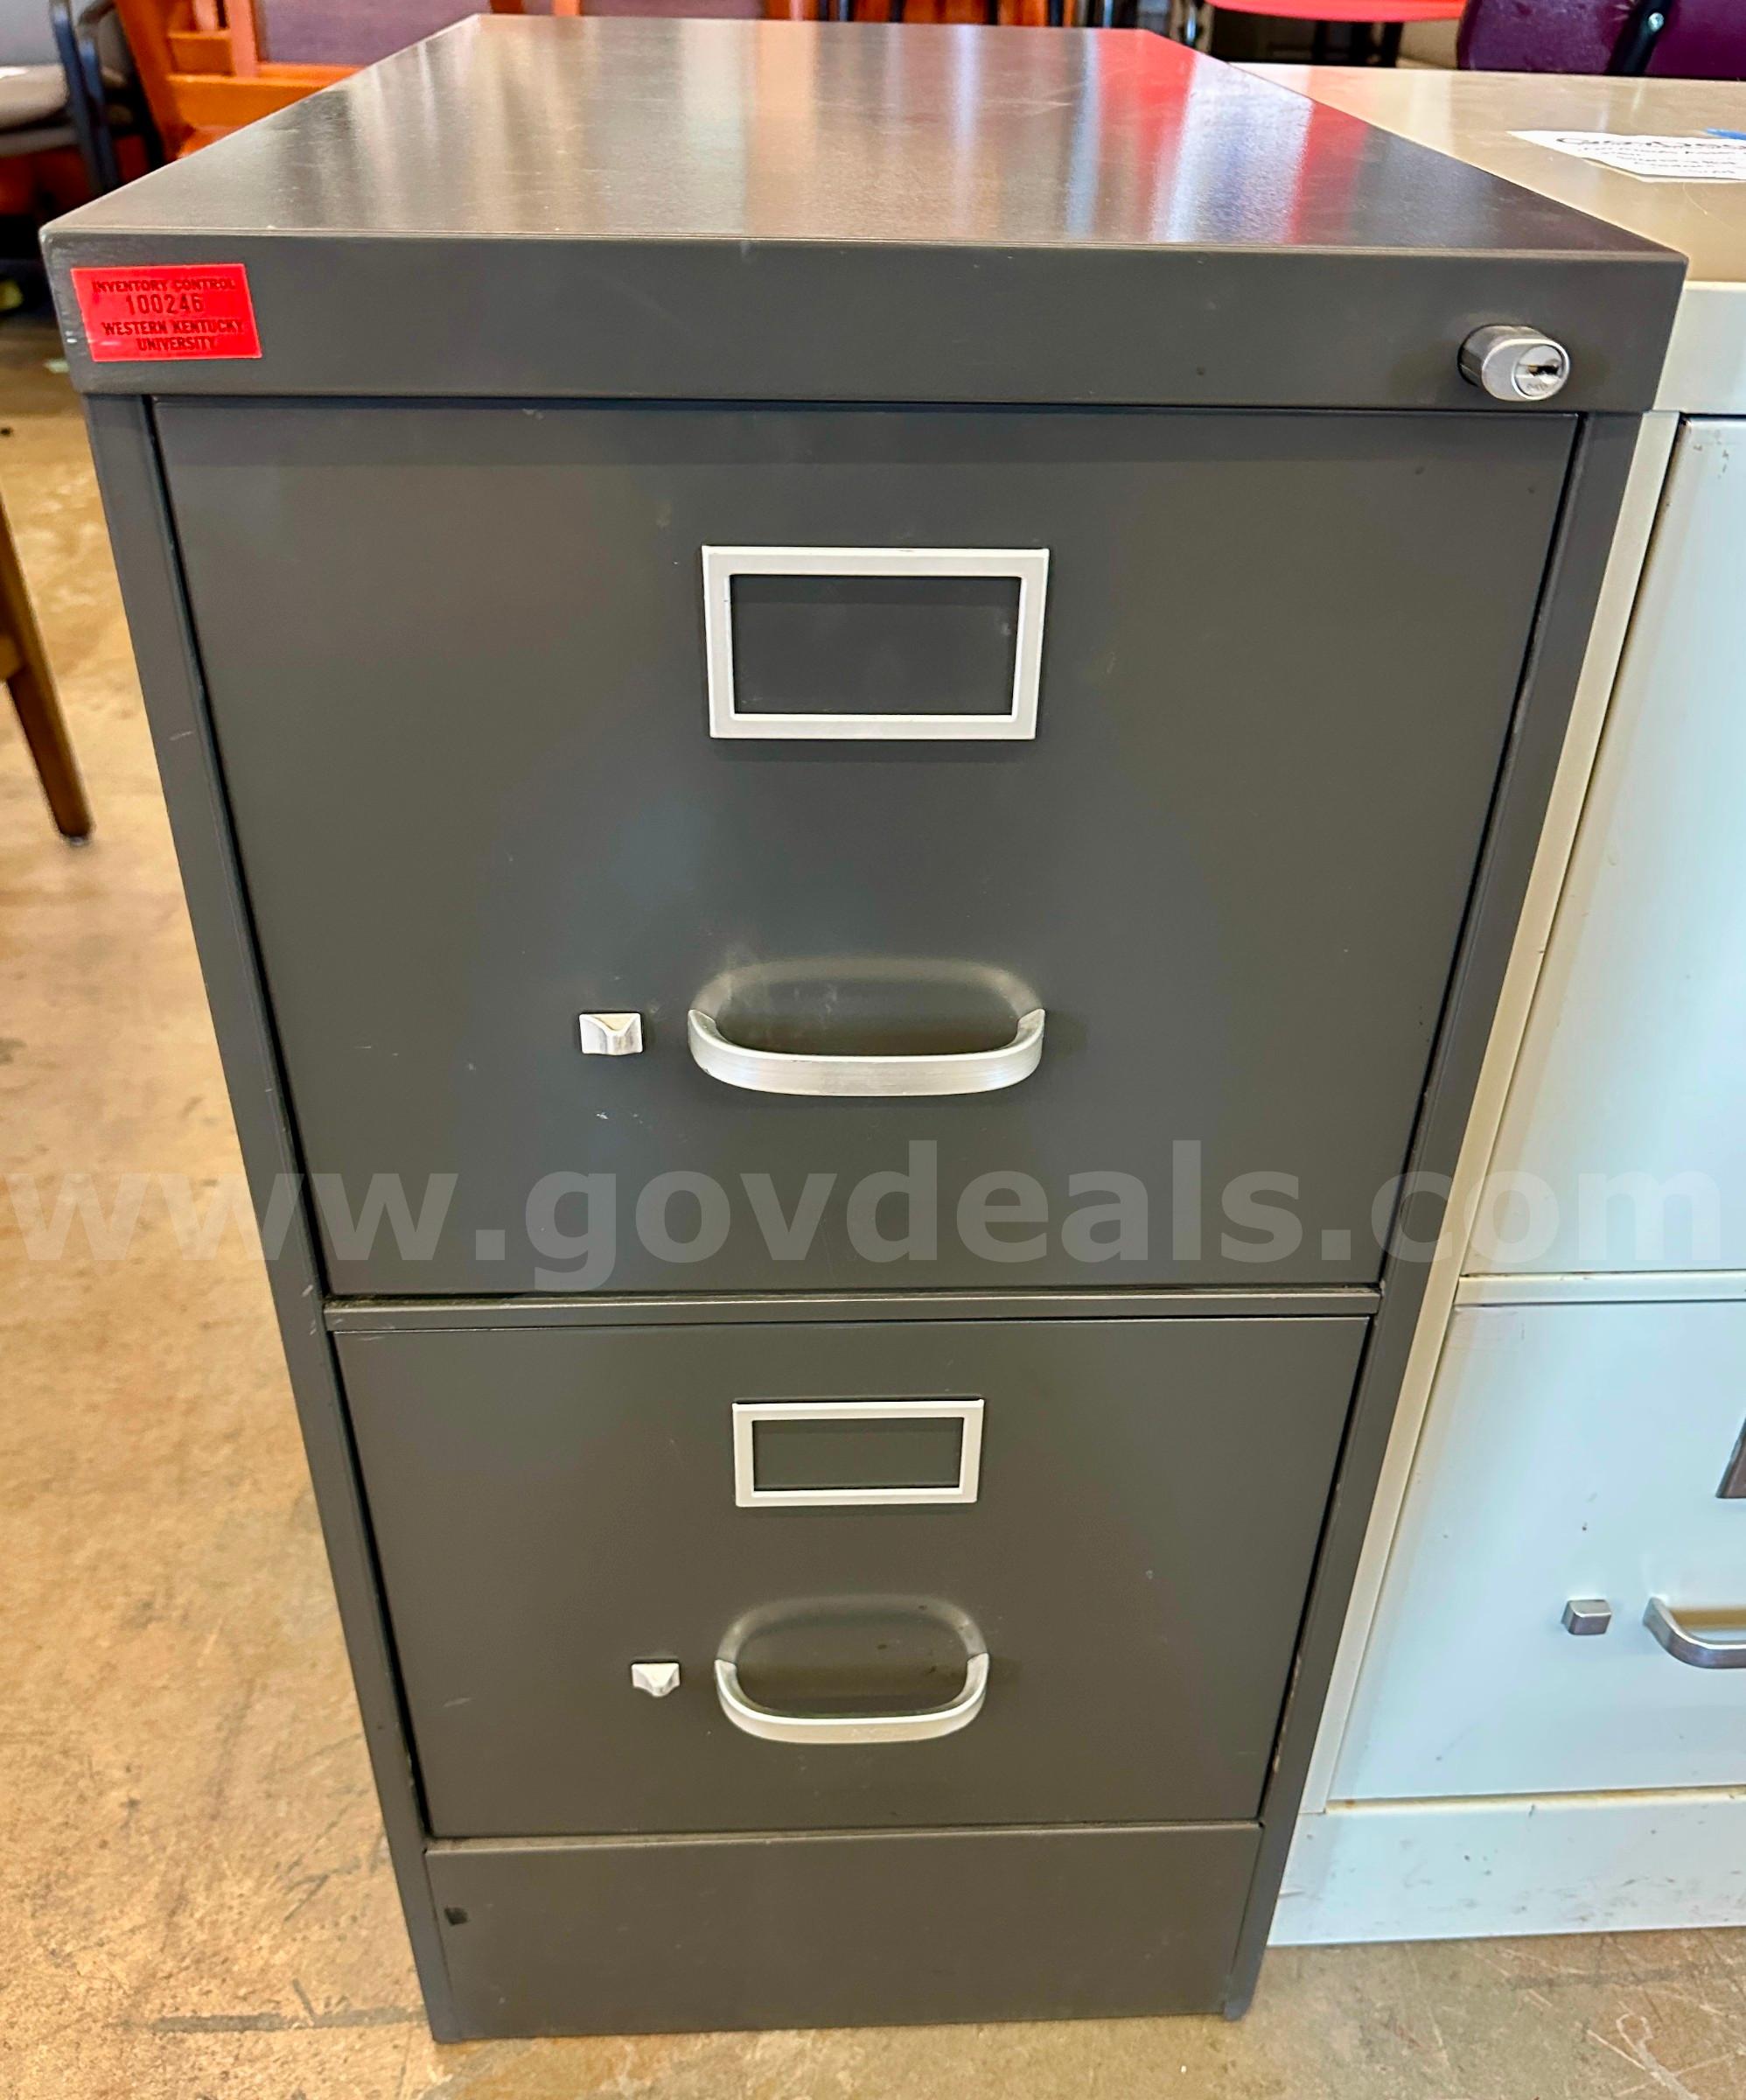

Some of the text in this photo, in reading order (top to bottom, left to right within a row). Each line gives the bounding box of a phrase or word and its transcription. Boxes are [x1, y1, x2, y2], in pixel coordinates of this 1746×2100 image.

[92, 278, 236, 293] INVENTORY CONTROL
[125, 293, 205, 315] 100246
[101, 318, 245, 335] WESTERN KENTUCKY
[137, 335, 216, 351] UNIVERSITY
